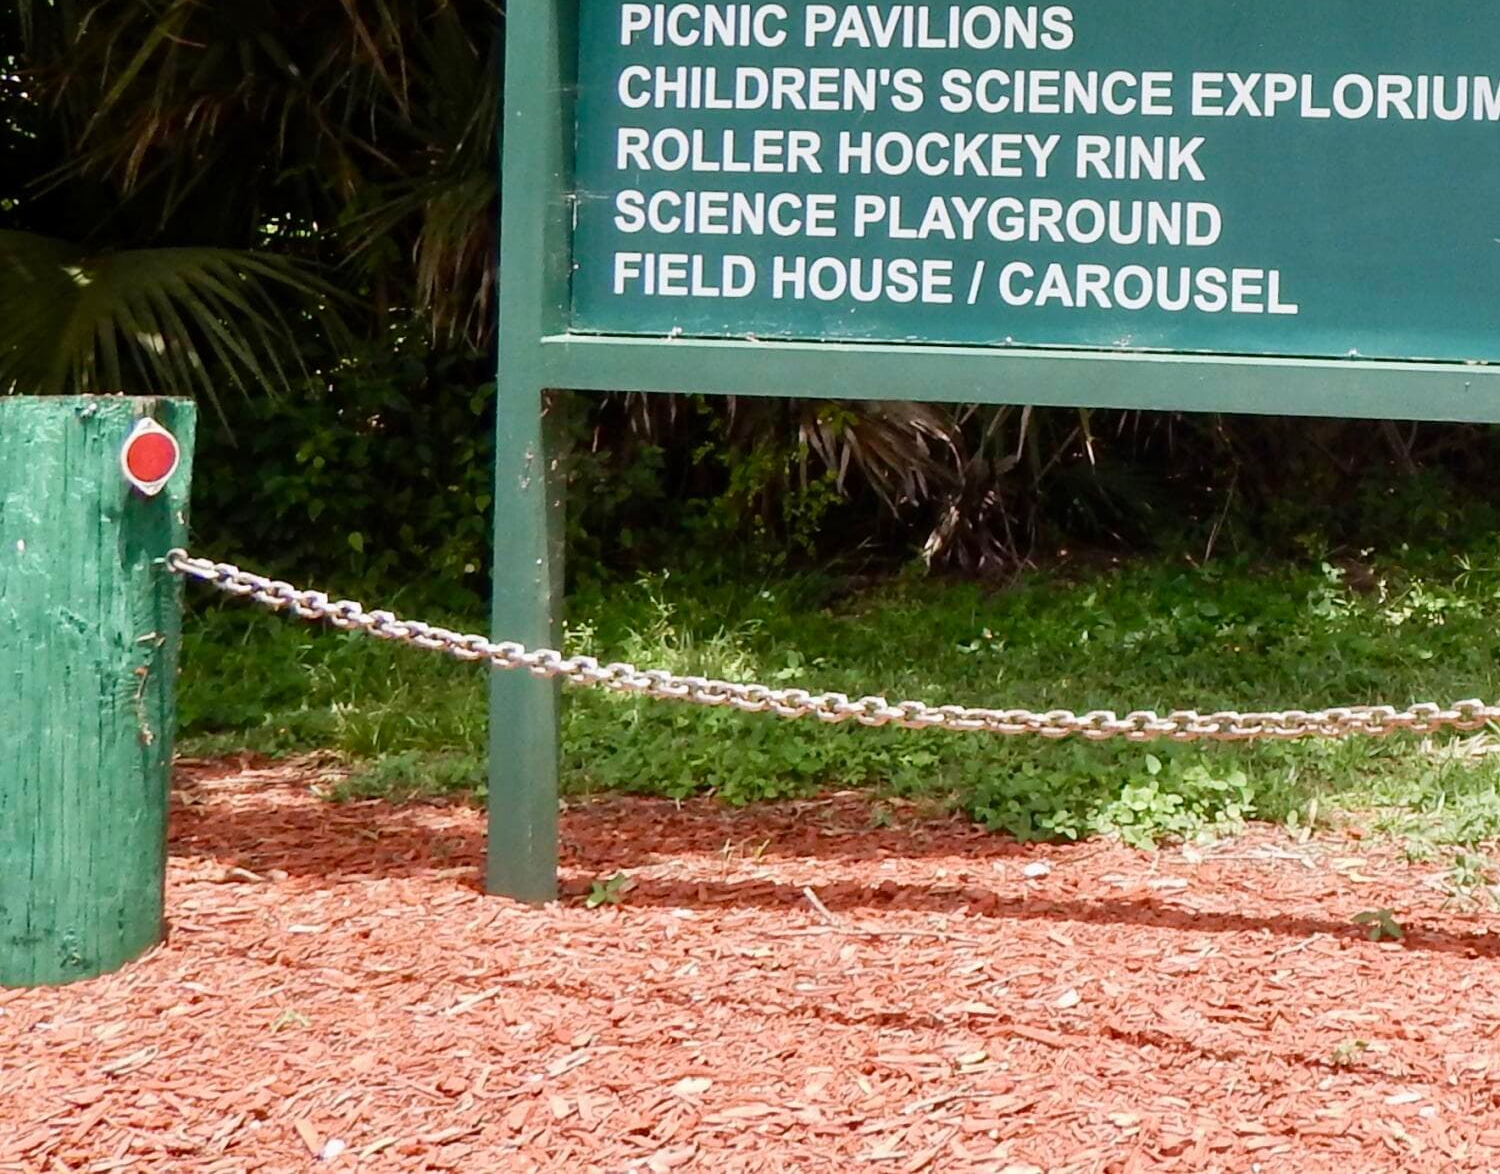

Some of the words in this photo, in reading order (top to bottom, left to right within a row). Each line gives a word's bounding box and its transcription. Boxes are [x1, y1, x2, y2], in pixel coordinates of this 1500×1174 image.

[620, 4, 787, 47] PICNIC
[804, 6, 1074, 50] PAVILIONS
[618, 66, 923, 112] CHILDREN'S
[939, 69, 1172, 115] SCIENCE
[616, 128, 822, 173] ROLLER
[838, 132, 1060, 178] HOCKEY
[1076, 135, 1205, 181] RINK
[614, 189, 837, 236] SCIENCE
[854, 194, 1221, 246] PLAYGROUND
[613, 252, 756, 298] FIELD
[773, 256, 953, 303] HOUSE
[967, 260, 985, 304] /
[999, 262, 1298, 314] CAROUSEL
